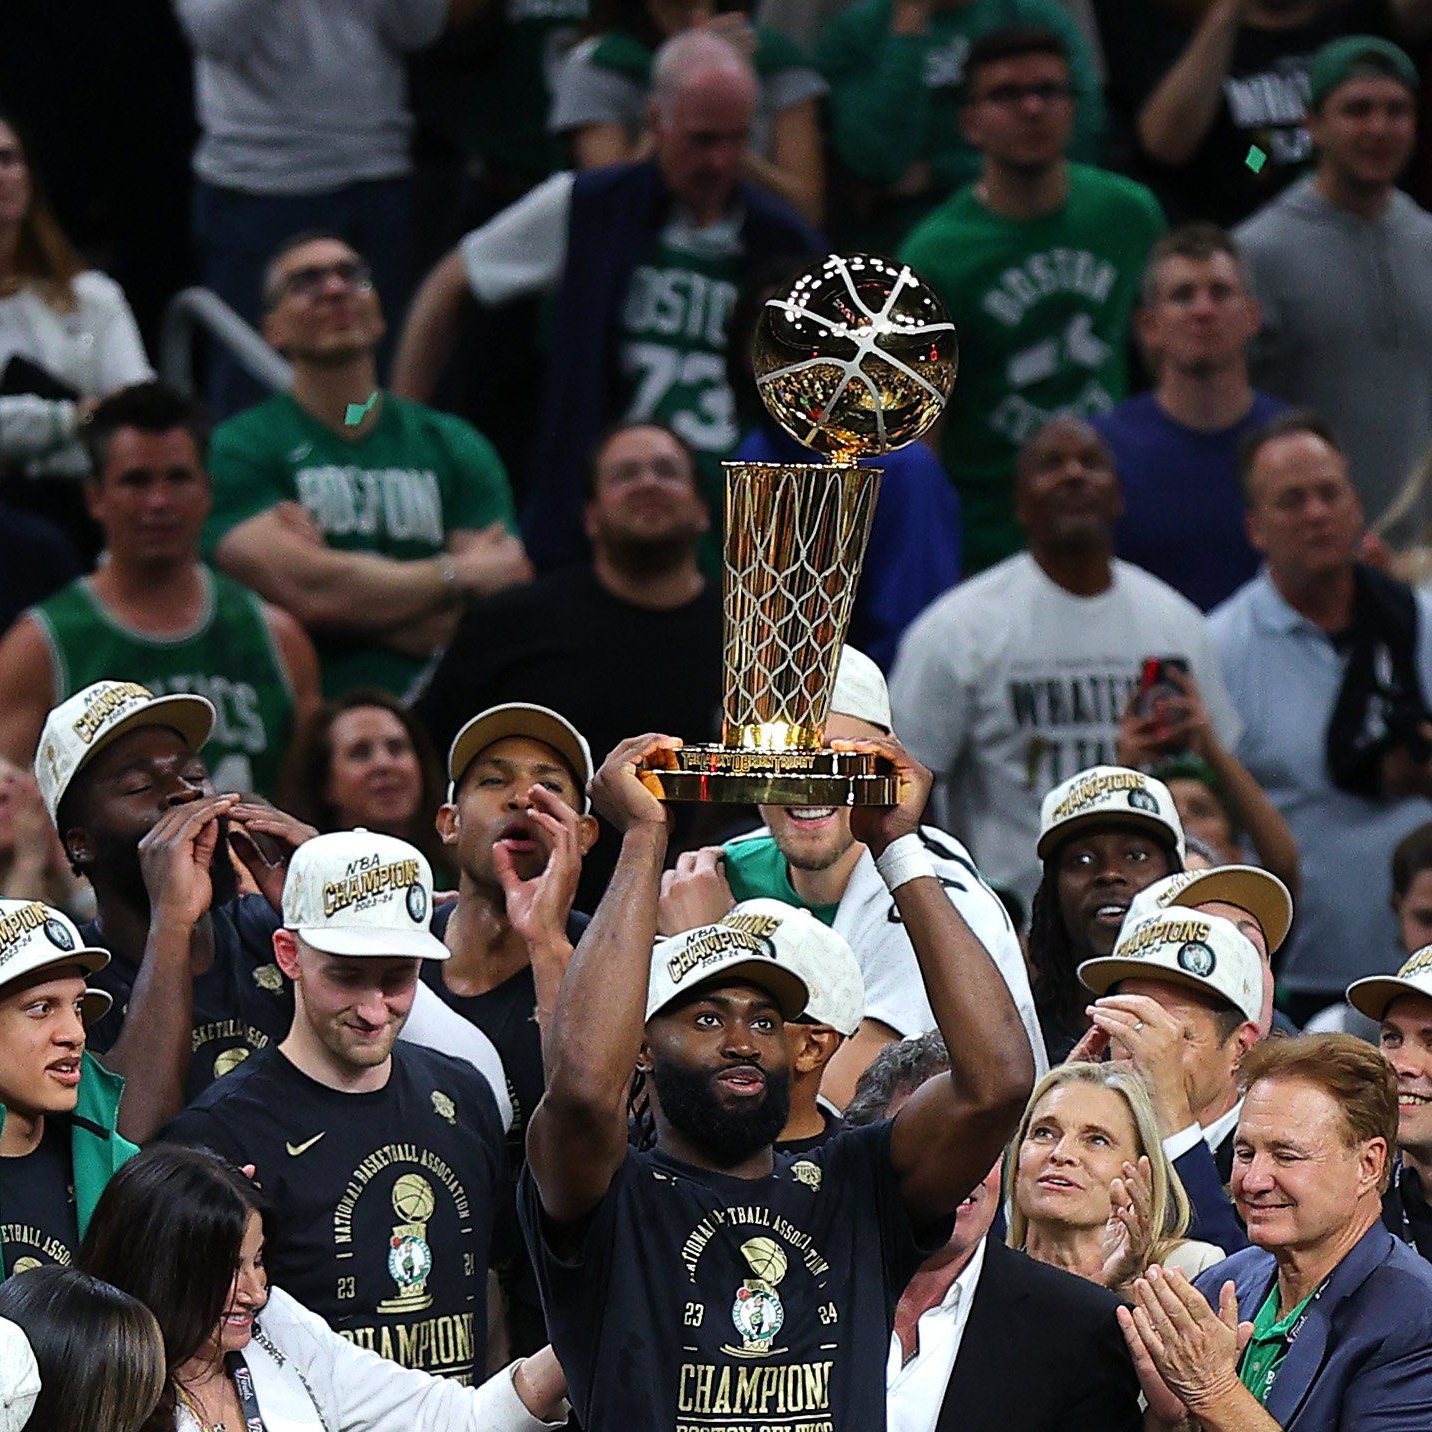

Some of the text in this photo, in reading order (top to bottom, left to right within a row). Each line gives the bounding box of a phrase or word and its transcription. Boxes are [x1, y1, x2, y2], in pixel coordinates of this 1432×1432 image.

[982, 248, 1113, 325] BOSTON
[623, 344, 739, 449] 73
[323, 858, 420, 918] CHAMPIONS
[346, 854, 380, 878] NBA
[667, 930, 764, 985] CHAMPIONS
[686, 926, 719, 947] NBA
[334, 1143, 471, 1244] NATIONAL BASKETBALL ASSOCIATION
[336, 1276, 356, 1300] 23
[684, 1302, 705, 1327] 23
[818, 1302, 839, 1326] 24
